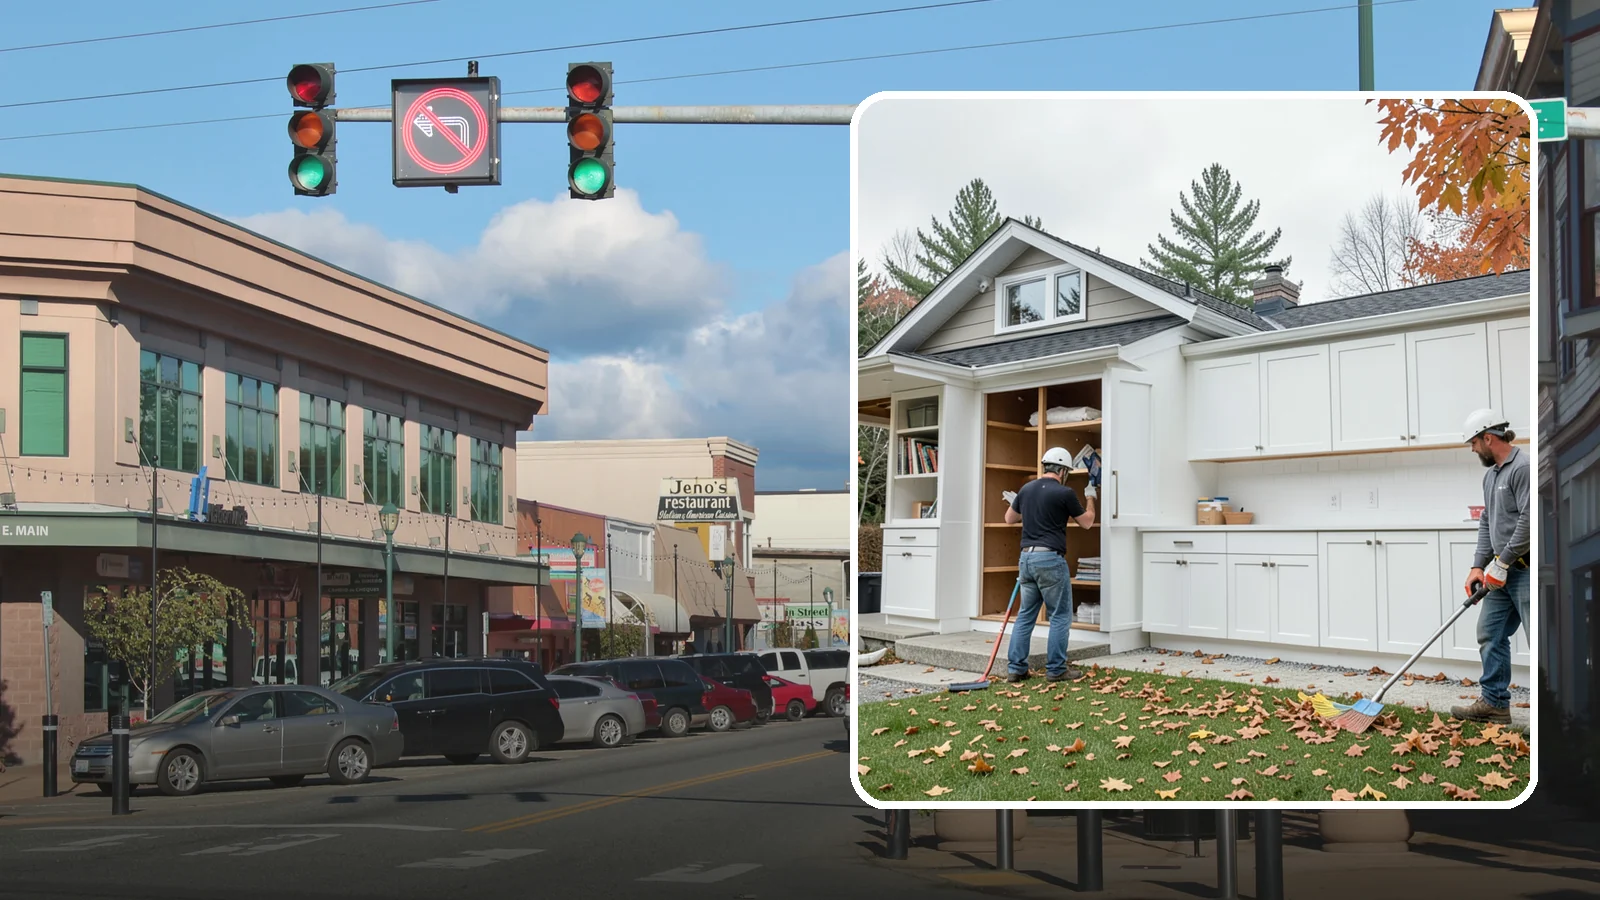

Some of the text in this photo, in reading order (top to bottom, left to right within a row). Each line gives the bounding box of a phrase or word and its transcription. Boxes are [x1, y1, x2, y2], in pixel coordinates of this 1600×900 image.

[670, 480, 727, 494] Jeno's
[665, 497, 730, 508] restaurant
[658, 510, 681, 519] Italian
[686, 510, 715, 519] American
[715, 509, 738, 519] Cuisine
[2, 525, 49, 536] E. MAIN
[797, 608, 828, 616] Street
